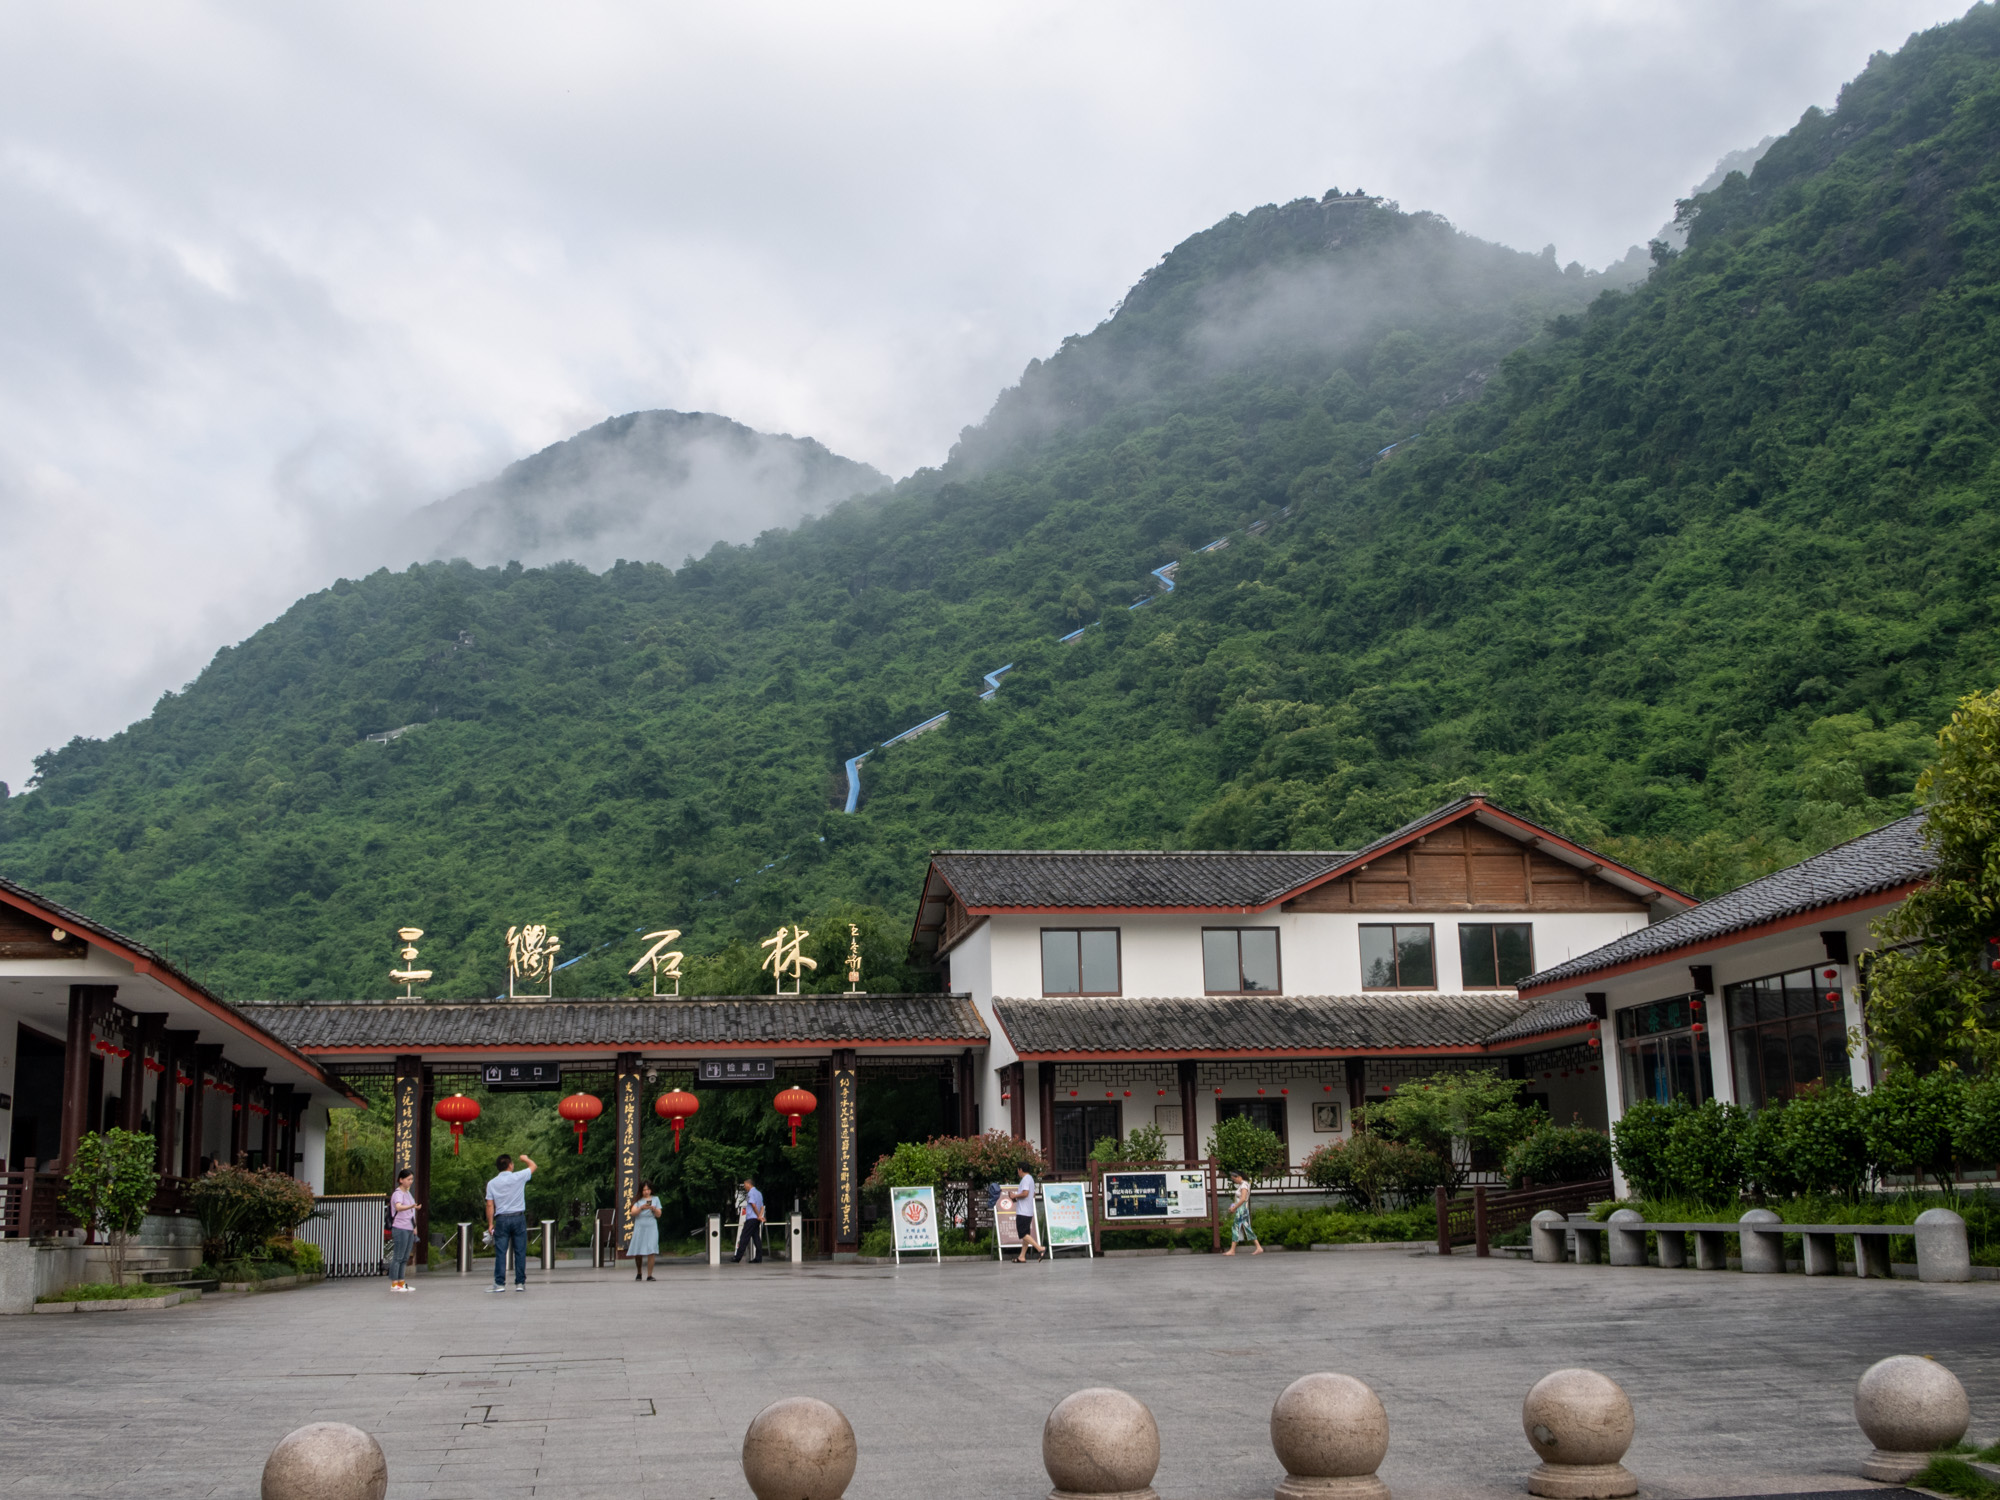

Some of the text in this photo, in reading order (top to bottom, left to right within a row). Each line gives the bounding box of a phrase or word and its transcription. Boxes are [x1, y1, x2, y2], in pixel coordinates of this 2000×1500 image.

[1648, 1004, 1681, 1032] 茶吧
[510, 1066, 543, 1077] 出口
[726, 1062, 766, 1072] 检票口
